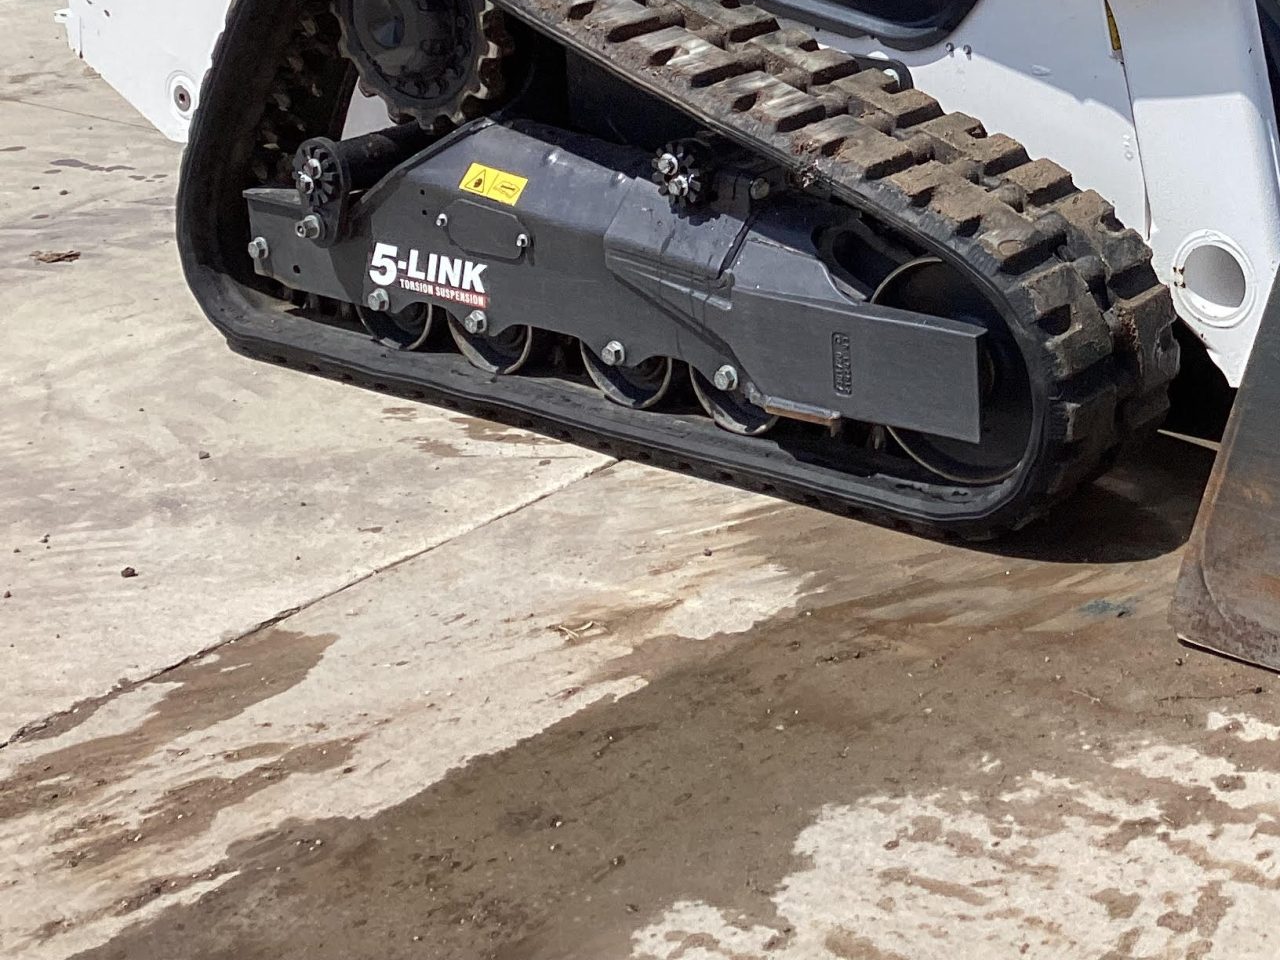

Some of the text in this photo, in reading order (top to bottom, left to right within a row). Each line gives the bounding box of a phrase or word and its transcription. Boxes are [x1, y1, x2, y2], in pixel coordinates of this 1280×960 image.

[369, 242, 488, 294] 5-LINK
[400, 278, 485, 308] TORSION SUSPENSION
